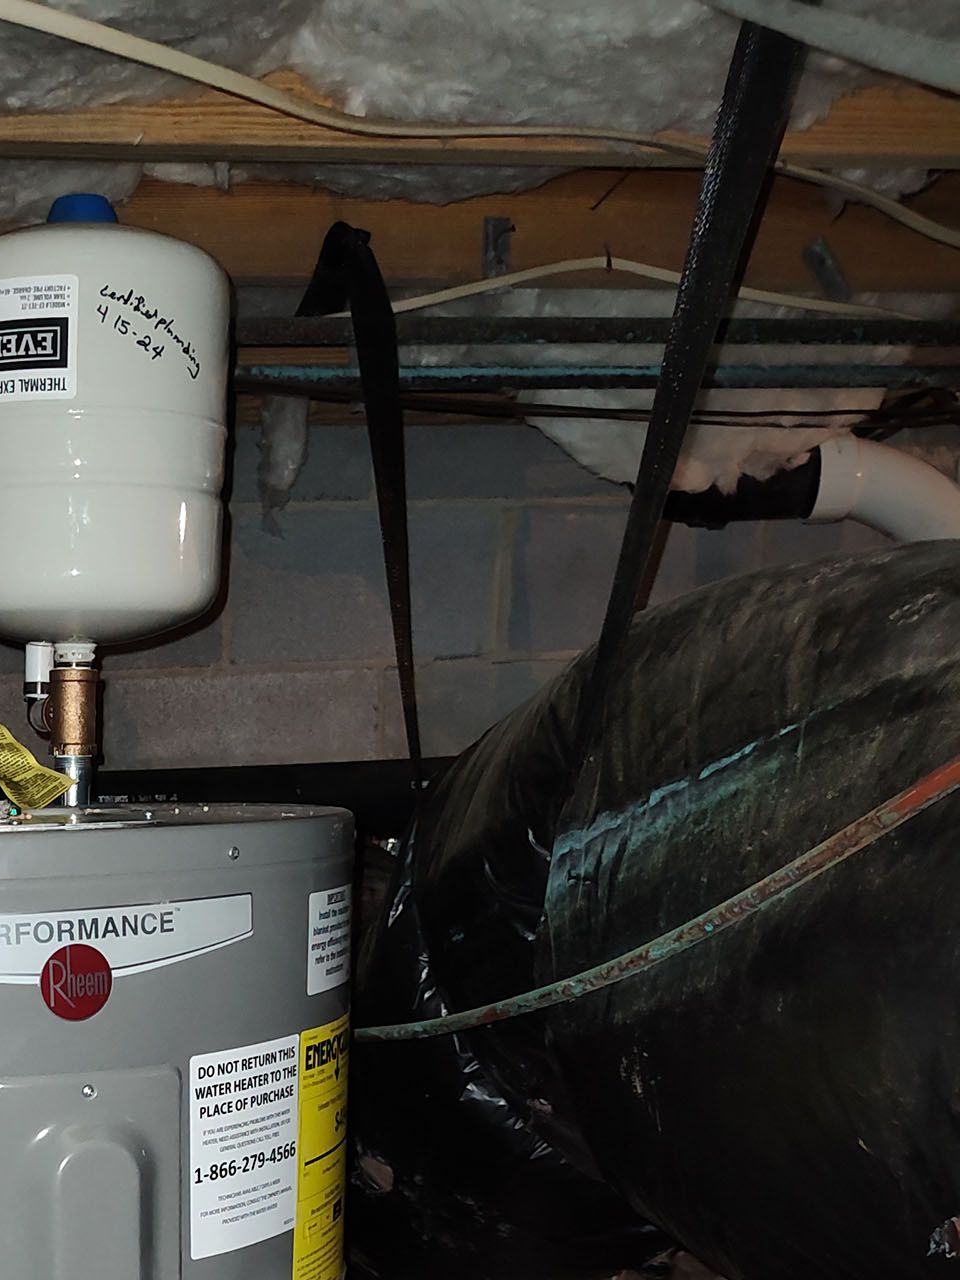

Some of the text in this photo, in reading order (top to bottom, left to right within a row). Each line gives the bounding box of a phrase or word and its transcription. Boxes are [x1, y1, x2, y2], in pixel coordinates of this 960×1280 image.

[19, 377, 67, 392] THERMAL
[49, 946, 108, 1008] Rheem
[198, 1046, 296, 1079] DO NOT RETURN THIS
[195, 1082, 232, 1100] WATER
[234, 1073, 269, 1092] HEATER
[270, 1069, 282, 1083] TO
[282, 1064, 297, 1080] THE
[200, 1084, 294, 1119] PLACE OF PURCHASE
[194, 1140, 296, 1184] 1-866-279-4566
